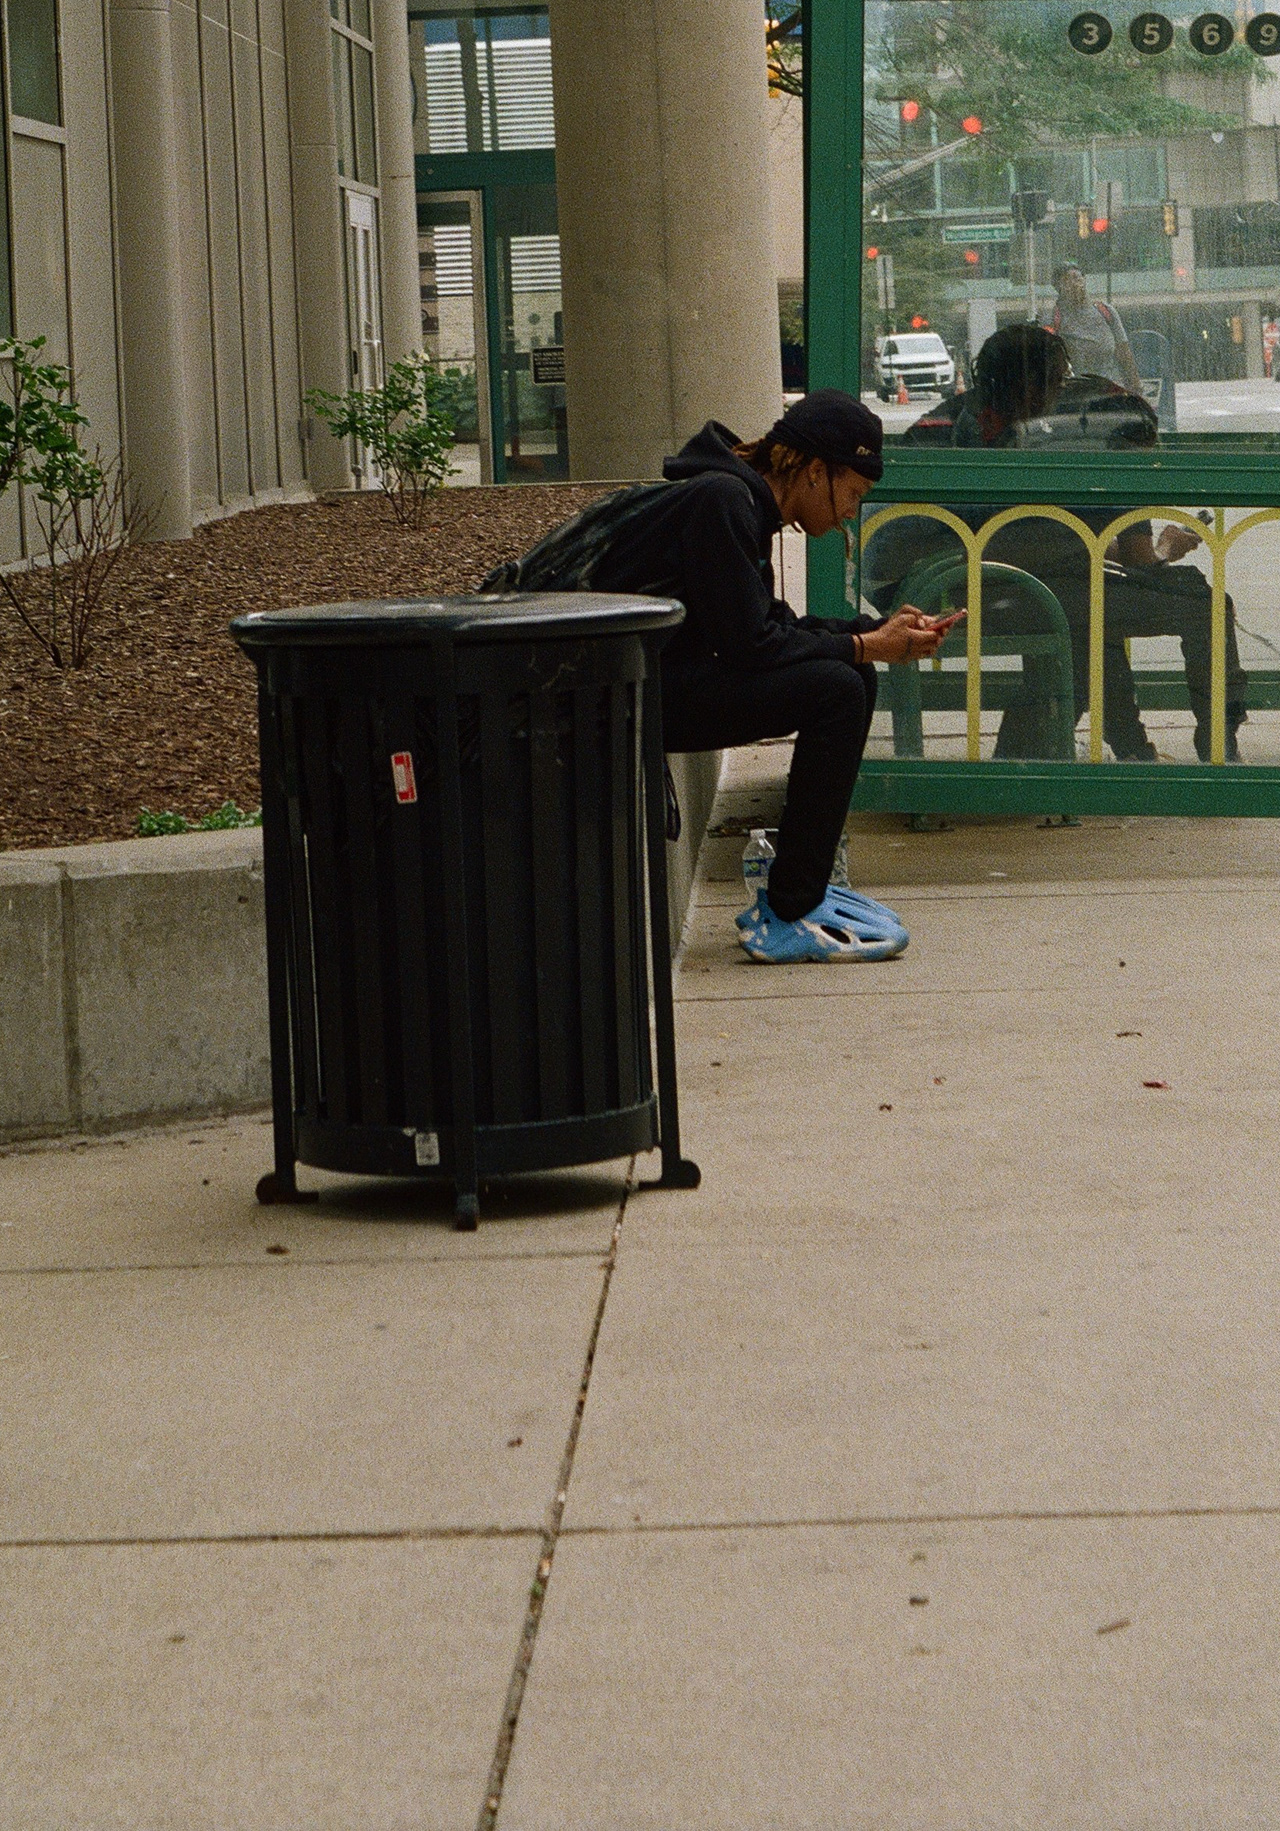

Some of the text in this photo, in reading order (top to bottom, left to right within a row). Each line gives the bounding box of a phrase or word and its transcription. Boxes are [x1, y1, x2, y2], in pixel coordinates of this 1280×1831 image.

[1081, 22, 1279, 46] 3 5 6 9
